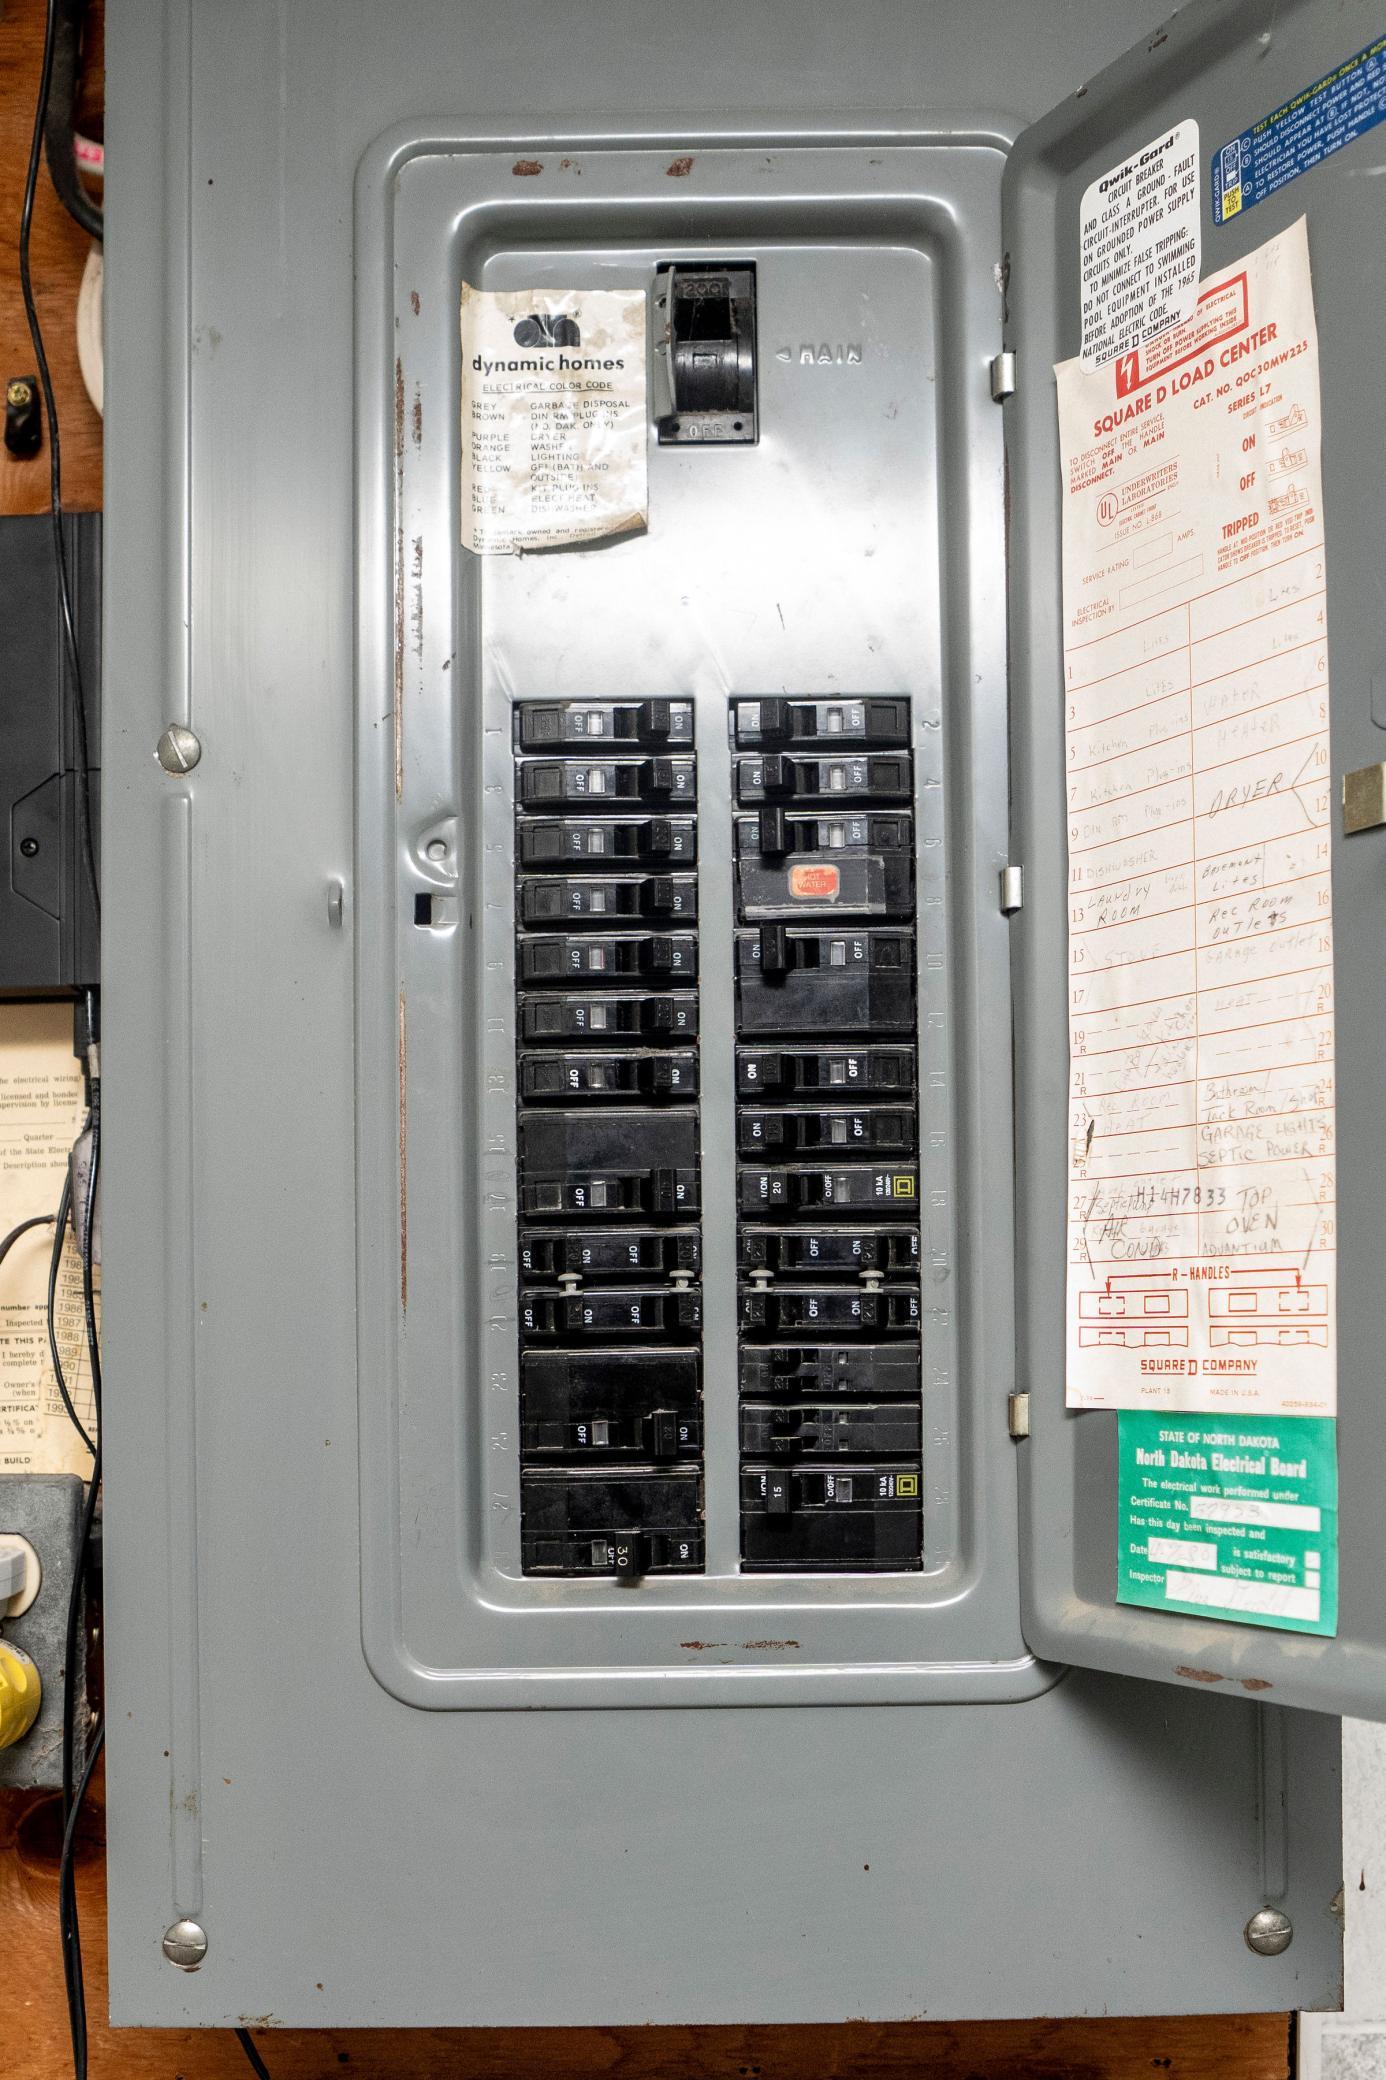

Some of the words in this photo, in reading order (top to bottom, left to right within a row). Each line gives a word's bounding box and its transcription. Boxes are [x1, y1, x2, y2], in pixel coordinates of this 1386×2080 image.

[1253, 128, 1272, 145] PUSH
[1276, 107, 1305, 131] YELLOW
[1310, 92, 1327, 108] TEST
[1331, 69, 1363, 94] BUTTON
[1253, 135, 1279, 157] SHOULD
[1280, 107, 1320, 139] DISCONNECT
[1322, 91, 1347, 114] POWER
[1253, 120, 1267, 134] TEST
[1327, 125, 1346, 142] PUSH
[1347, 106, 1376, 128] HANDLE
[1304, 152, 1321, 168] THEN
[1323, 139, 1342, 156] TURN
[1108, 179, 1131, 203] CIRCUIT
[1136, 159, 1164, 186] BREAKER
[1164, 182, 1178, 200] FOR
[1182, 170, 1195, 188] USE
[1084, 218, 1097, 235] AND
[1101, 203, 1120, 223] CLASS
[1137, 174, 1165, 200] GROUND
[1174, 154, 1195, 177] FAULT
[1083, 253, 1093, 266] ON
[1097, 226, 1134, 258] GROUNDED
[1138, 207, 1164, 233] POWER
[1168, 187, 1195, 214] SUPPLY
[1083, 257, 1110, 282] CIRCUITS
[1114, 244, 1133, 263] ONLY.
[1090, 281, 1098, 294] TO
[1101, 260, 1130, 288] MINIMIZE
[1134, 246, 1153, 268] FALSE
[1155, 227, 1188, 254] TRIPPING:
[1083, 300, 1093, 314] DO
[1096, 289, 1109, 306] NOT
[1112, 269, 1141, 296] CONNECT
[1145, 262, 1154, 277] TO
[1157, 238, 1195, 269] SWIMMING
[1084, 310, 1103, 329] POOL
[1107, 281, 1150, 316] EQUIPMENT
[1154, 255, 1196, 288] INSTALLED
[1084, 322, 1106, 345] BEFORE
[1110, 301, 1144, 330] ADOPTION
[1148, 293, 1157, 308] OF
[1161, 284, 1173, 300] THE
[1178, 270, 1195, 290] 1965
[1082, 334, 1114, 360] NATIONAL
[1119, 315, 1145, 340] ELECTRIC
[1095, 338, 1130, 364] SQUARE
[1141, 309, 1181, 339] COMPANY
[473, 355, 554, 376] dynamic
[559, 354, 624, 370] homes
[800, 344, 863, 365] MAIN
[550, 382, 582, 390] COLOR
[586, 380, 613, 389] CODE
[1094, 392, 1151, 437] SQUARE
[1157, 386, 1166, 404] D
[1171, 359, 1215, 396] LOAD
[1220, 322, 1277, 368] CENTER
[1193, 392, 1213, 410] CAT.
[1217, 384, 1232, 398] NO.
[1228, 391, 1255, 414] SERIES
[1260, 383, 1271, 397] L7
[689, 423, 724, 437] OFF
[1143, 431, 1166, 448] MAIN
[1242, 434, 1256, 452] ON
[531, 453, 580, 461] LIGHTING
[1070, 469, 1116, 494] DISCONNECT.
[1121, 461, 1178, 496] UNDERWRITERS
[1121, 472, 1179, 505] LABORATORIES
[1239, 472, 1256, 491] OFF
[1221, 511, 1259, 540] TRIPPED
[574, 715, 583, 734] OFF
[674, 714, 684, 731] ON
[851, 708, 861, 727] OFF
[576, 774, 585, 793] OFF
[676, 774, 685, 790] ON
[752, 770, 762, 786] ON
[853, 764, 863, 784] OFF
[1208, 772, 1284, 819] DRYER
[750, 825, 759, 841] ON
[852, 820, 862, 839] OFF
[572, 833, 581, 851] OFF
[674, 836, 683, 852] ON
[798, 879, 827, 890] WATER
[572, 892, 581, 911] OFF
[673, 895, 682, 911] ON
[571, 950, 580, 969] OFF
[854, 940, 863, 960] OFF
[1073, 990, 1086, 1003] 17
[569, 1068, 579, 1088] OFF
[849, 1059, 858, 1078] OFF
[575, 1188, 584, 1207] OFF
[773, 1182, 781, 1194] 20
[1236, 1186, 1272, 1209] TOP
[1226, 1210, 1278, 1234] OVEN
[810, 1238, 819, 1256] OFF
[853, 1240, 861, 1255] ON
[57, 1317, 81, 1327] 1987
[1141, 1359, 1185, 1371] SQUARE
[1187, 1359, 1198, 1375] D
[1203, 1359, 1258, 1371] COMPANY
[1159, 1430, 1185, 1443] STATE
[1187, 1432, 1200, 1443] OF
[1203, 1433, 1236, 1446] NORTH
[1239, 1435, 1280, 1449] DAKOTA
[1136, 1448, 1165, 1467] North
[1171, 1450, 1207, 1470] Dakota
[1212, 1453, 1265, 1475] Electrical
[1270, 1457, 1307, 1479] Board
[773, 1486, 782, 1498] 15
[1142, 1477, 1158, 1489] The
[1161, 1480, 1197, 1492] electrical
[1200, 1483, 1221, 1495] work
[1224, 1486, 1269, 1499] performed
[1273, 1490, 1299, 1501] under
[1130, 1496, 1171, 1510] Certificate
[1175, 1500, 1189, 1511] No.
[1130, 1515, 1146, 1525] Has
[1148, 1518, 1163, 1528] this
[1166, 1519, 1181, 1531] day
[1184, 1521, 1202, 1531] been
[1205, 1523, 1246, 1538] inspected
[1248, 1528, 1266, 1540] and
[618, 1546, 628, 1566] 30
[1130, 1543, 1148, 1555] Date
[1232, 1547, 1241, 1558] is
[1244, 1548, 1296, 1567] satisfactory
[1129, 1569, 1165, 1584] Inspector
[1221, 1562, 1252, 1577] subject
[1255, 1567, 1264, 1578] to
[1268, 1570, 1296, 1584] report
